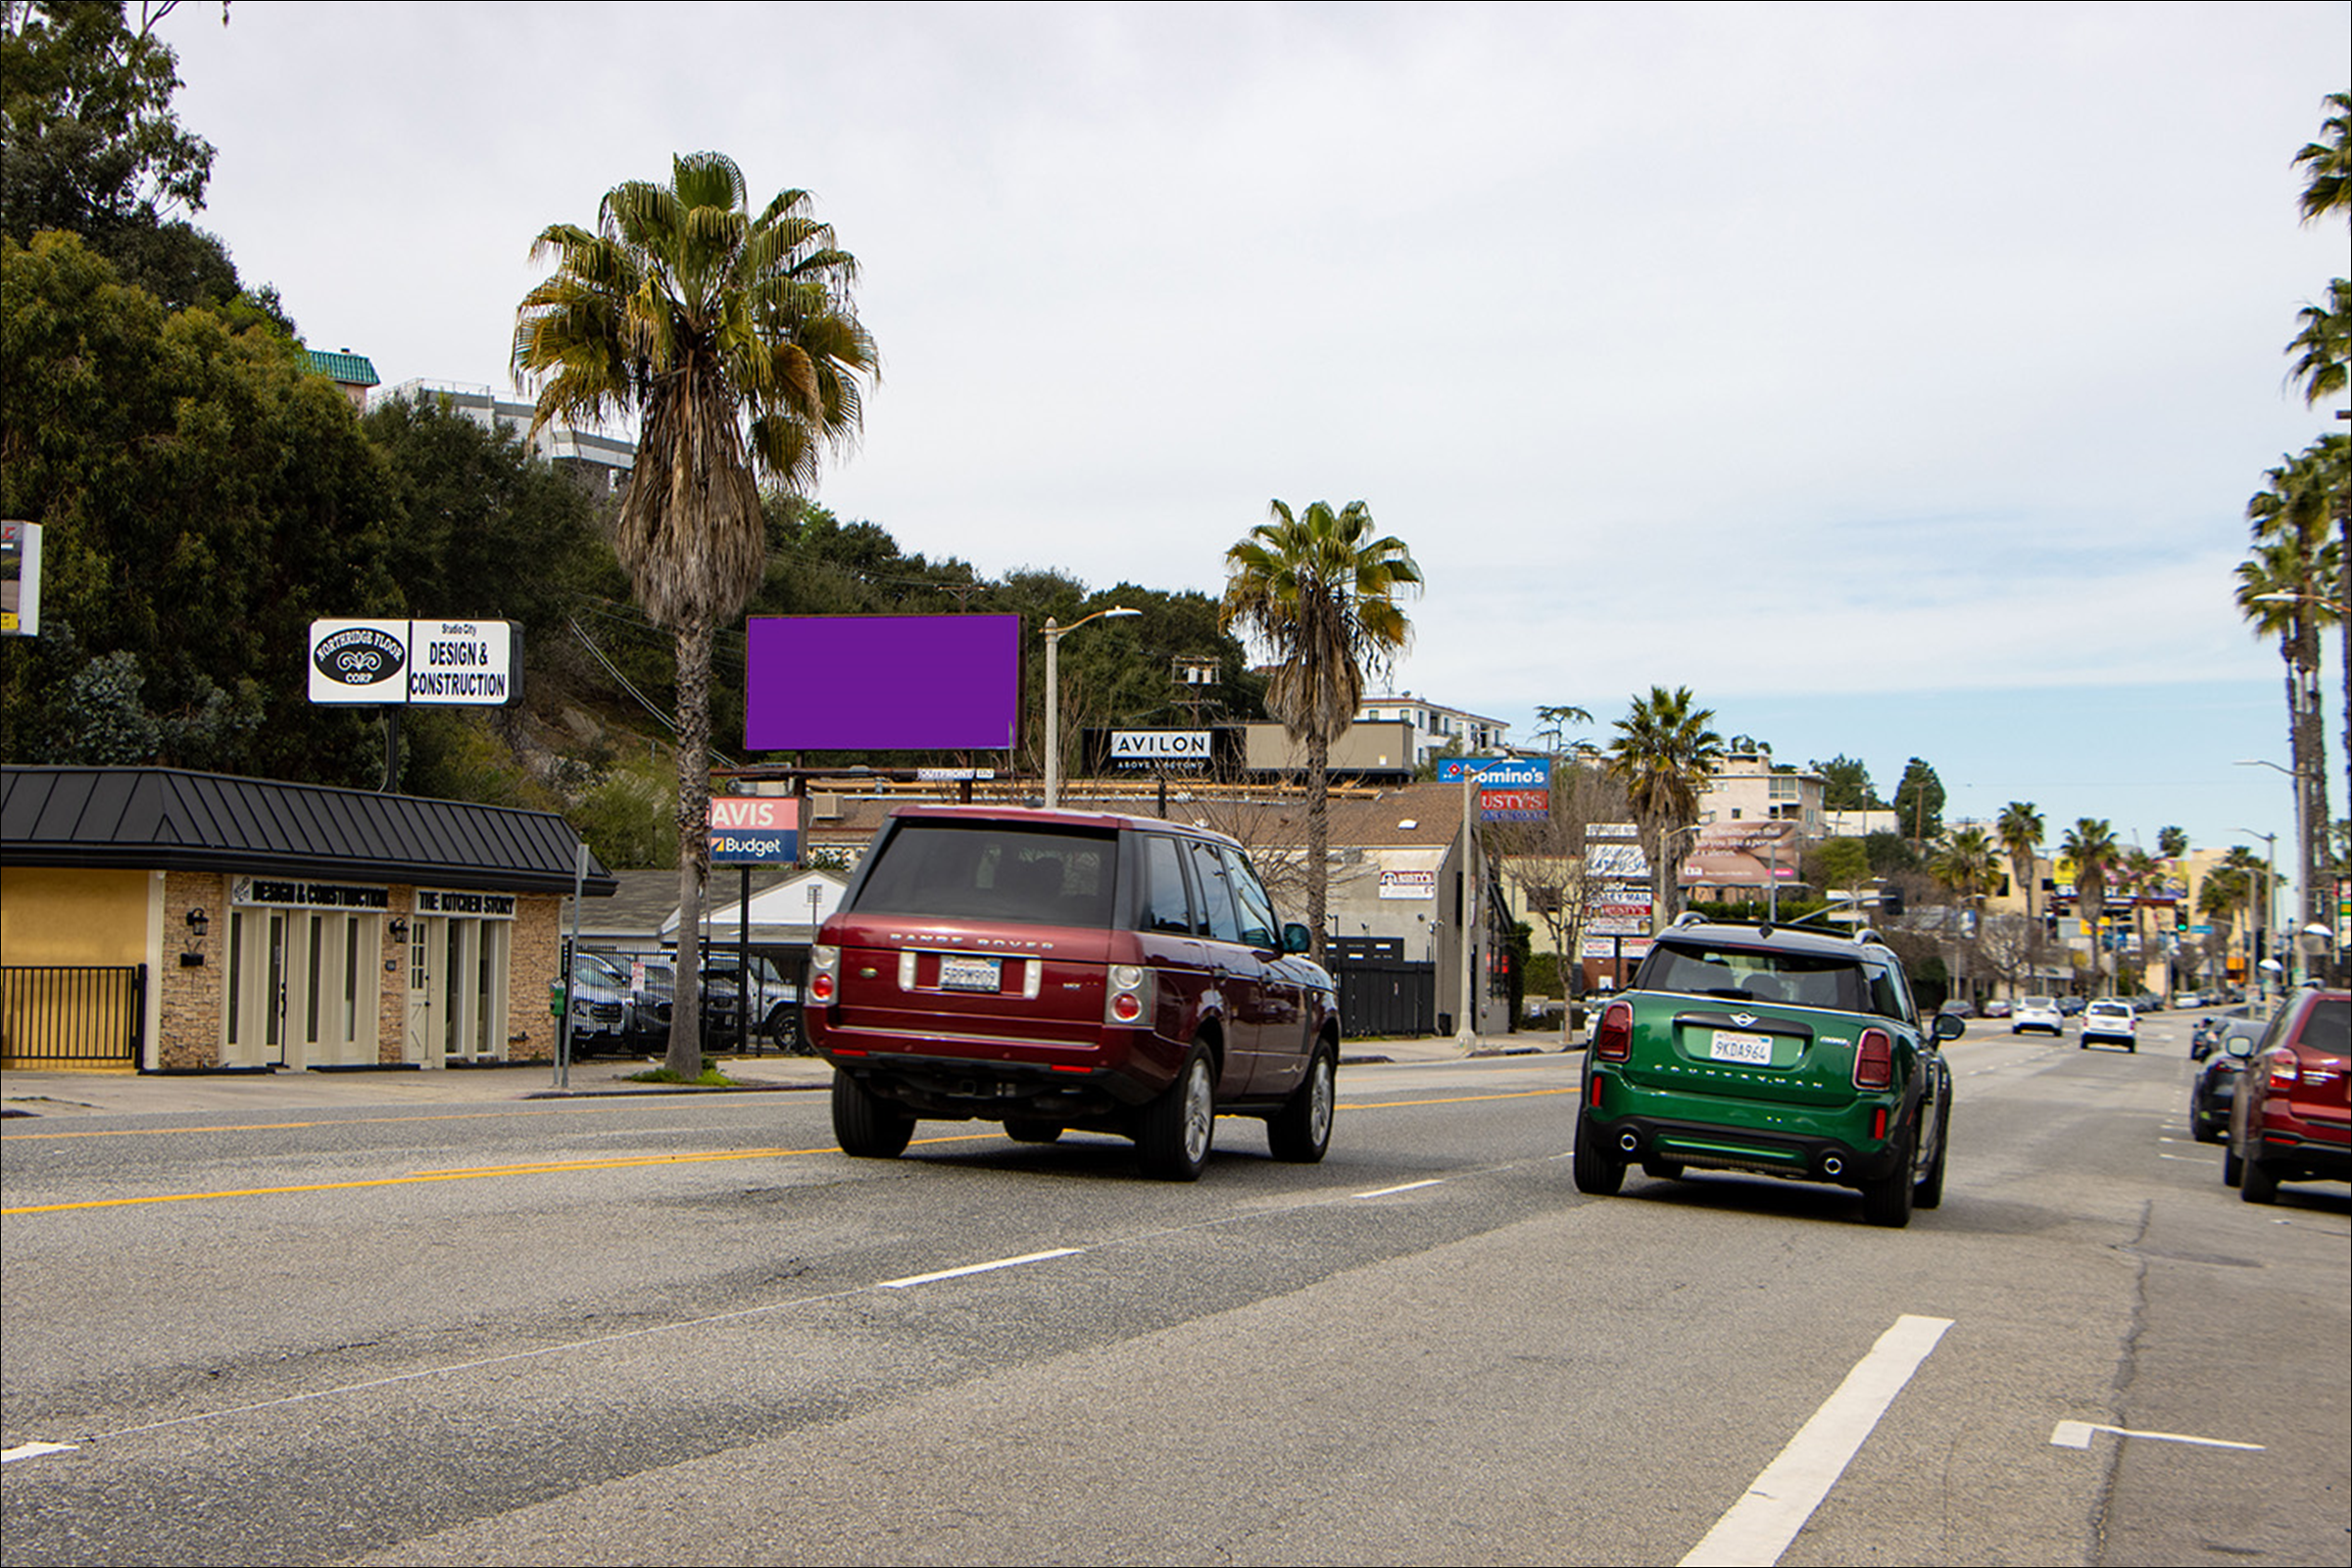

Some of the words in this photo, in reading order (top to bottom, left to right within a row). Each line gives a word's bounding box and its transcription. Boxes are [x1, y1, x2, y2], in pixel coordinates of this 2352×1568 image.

[441, 623, 463, 635] Studio
[464, 623, 477, 637] City
[317, 630, 373, 662] NORTHRIDGE
[374, 632, 404, 662] FLOOR
[429, 641, 476, 666] DESIGN
[478, 642, 488, 666] &
[345, 673, 372, 684] CORP
[410, 672, 506, 697] CONSTRUCTION
[1118, 736, 1204, 752] AVILON
[711, 803, 774, 826] AVIS
[725, 837, 781, 858] Budget
[253, 880, 296, 903] DESIGN
[296, 883, 306, 904] &
[307, 884, 388, 907] CONSTRUCTION
[418, 891, 440, 910] THE
[441, 892, 482, 912] KITCHEN
[483, 895, 515, 914] STORY
[890, 933, 963, 944] RANGE
[977, 938, 1054, 950] ROVER
[1715, 1041, 1767, 1060] 9KDA964
